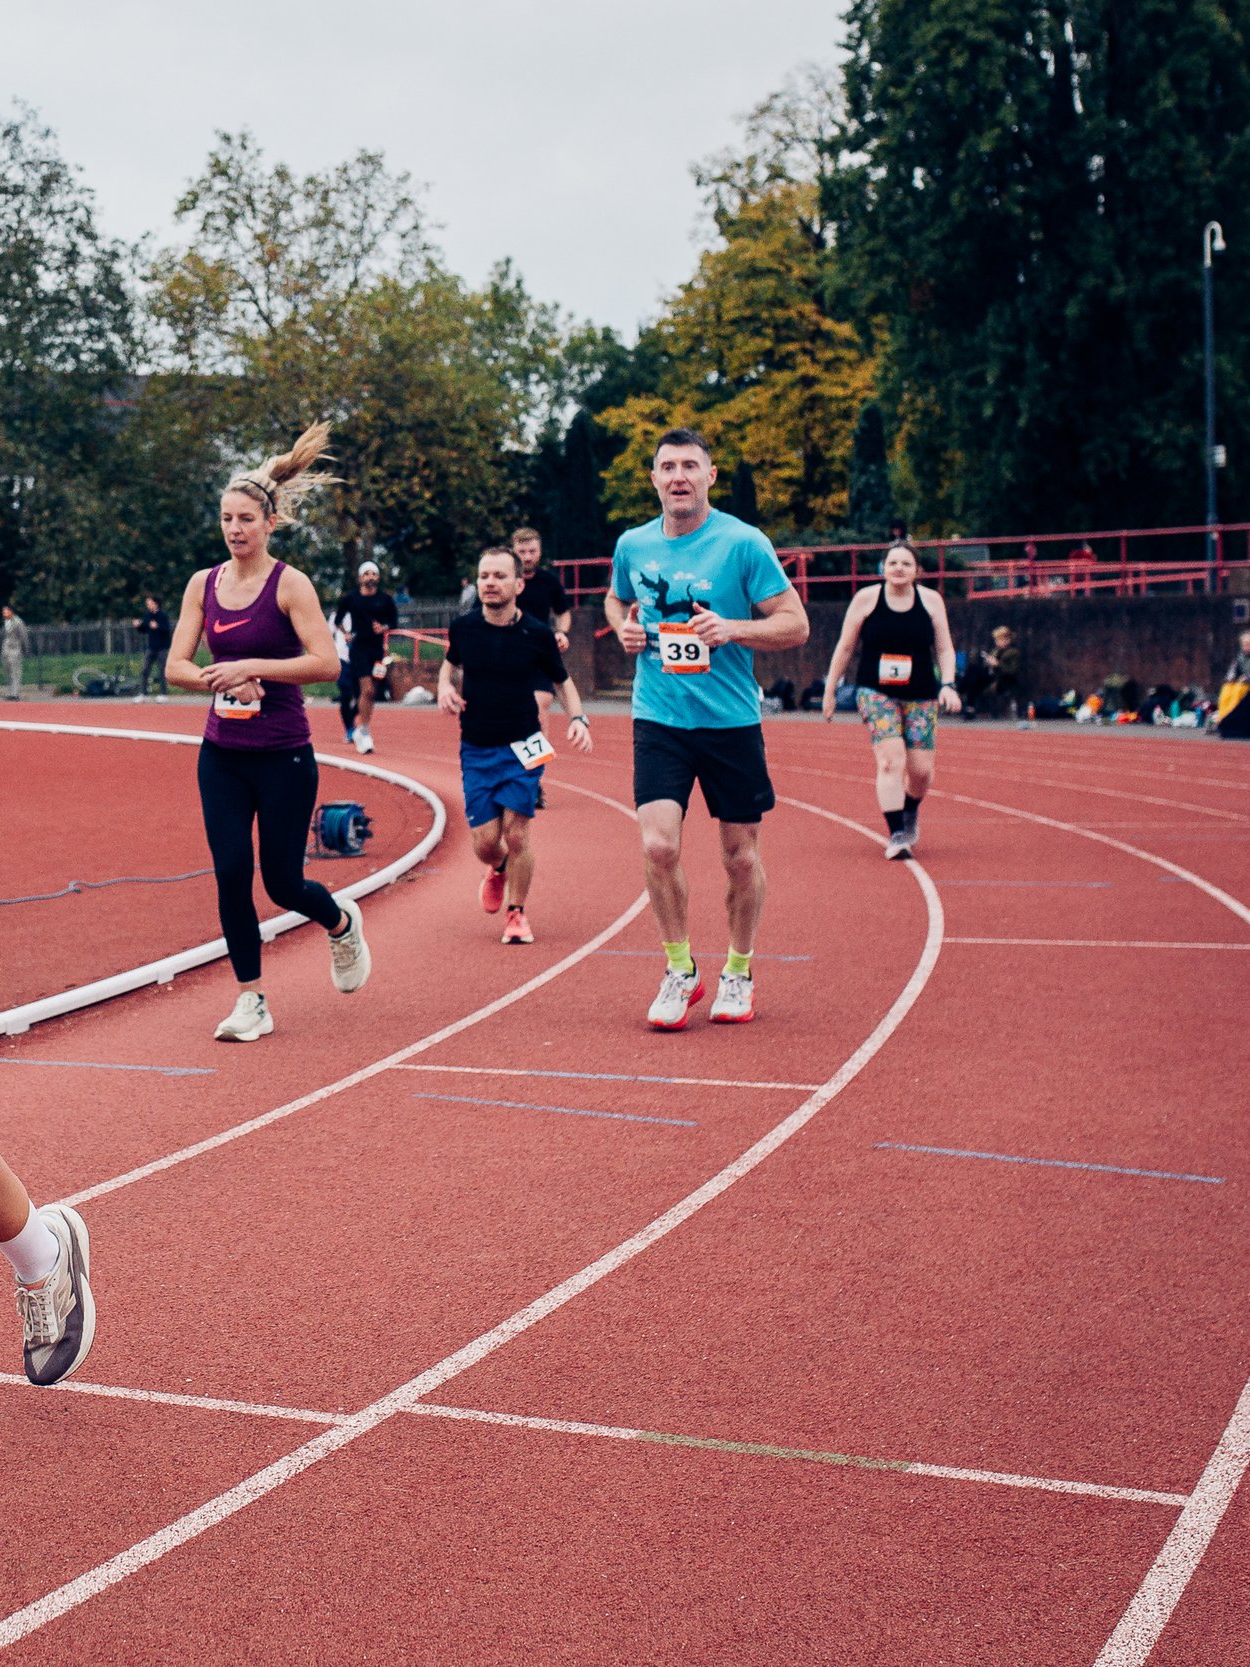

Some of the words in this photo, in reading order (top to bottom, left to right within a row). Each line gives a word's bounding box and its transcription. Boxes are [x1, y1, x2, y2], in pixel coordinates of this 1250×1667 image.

[667, 643, 701, 661] 39
[223, 692, 253, 706] 4
[522, 739, 543, 759] 17
